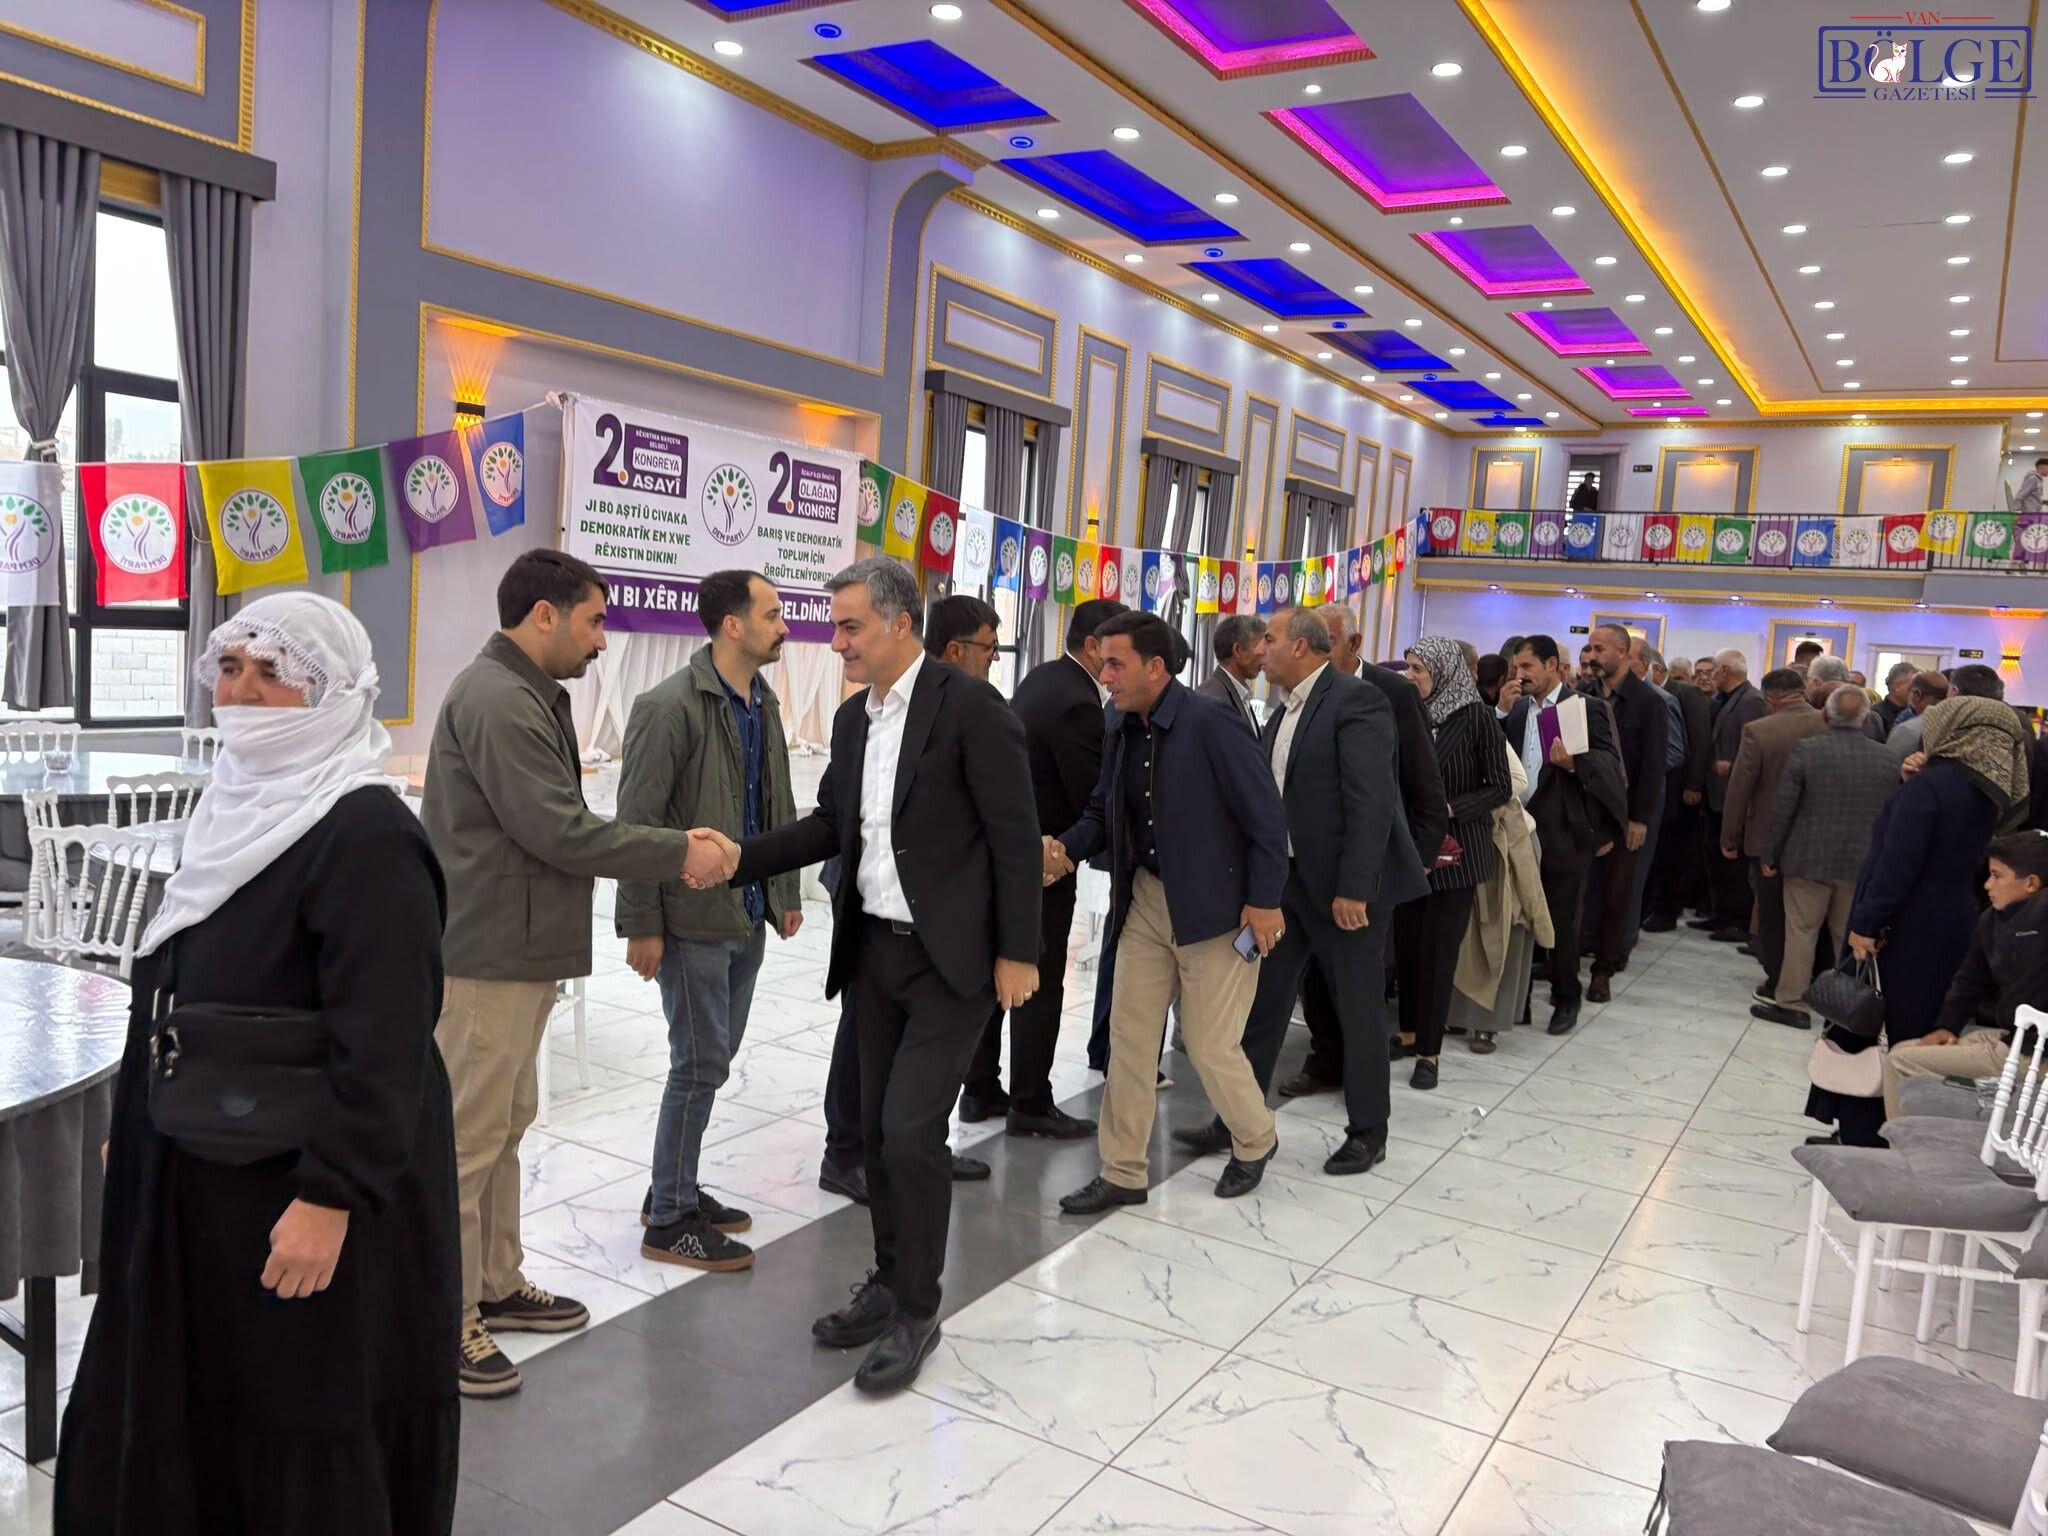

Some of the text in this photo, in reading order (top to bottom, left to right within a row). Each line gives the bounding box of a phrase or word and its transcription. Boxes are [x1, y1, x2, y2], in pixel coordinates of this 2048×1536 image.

[634, 452, 680, 473] KONGREYA
[632, 473, 681, 495] ASAYÎ
[800, 483, 836, 501] OLAĞAN
[585, 499, 597, 512] JI
[600, 501, 613, 514] BO
[652, 509, 688, 525] CIVAKA
[798, 501, 837, 520] KONGRE
[580, 520, 691, 546] DEMOKRATÎK EM XWE
[712, 526, 725, 541] DEM
[757, 526, 843, 549] BARIŞ VE DEMOKRATİK
[594, 542, 677, 565] RÊXISTIN DIKIN!
[778, 548, 826, 566] TOPLUM İÇİN
[623, 585, 640, 608] BI
[643, 584, 677, 611] XÊR
